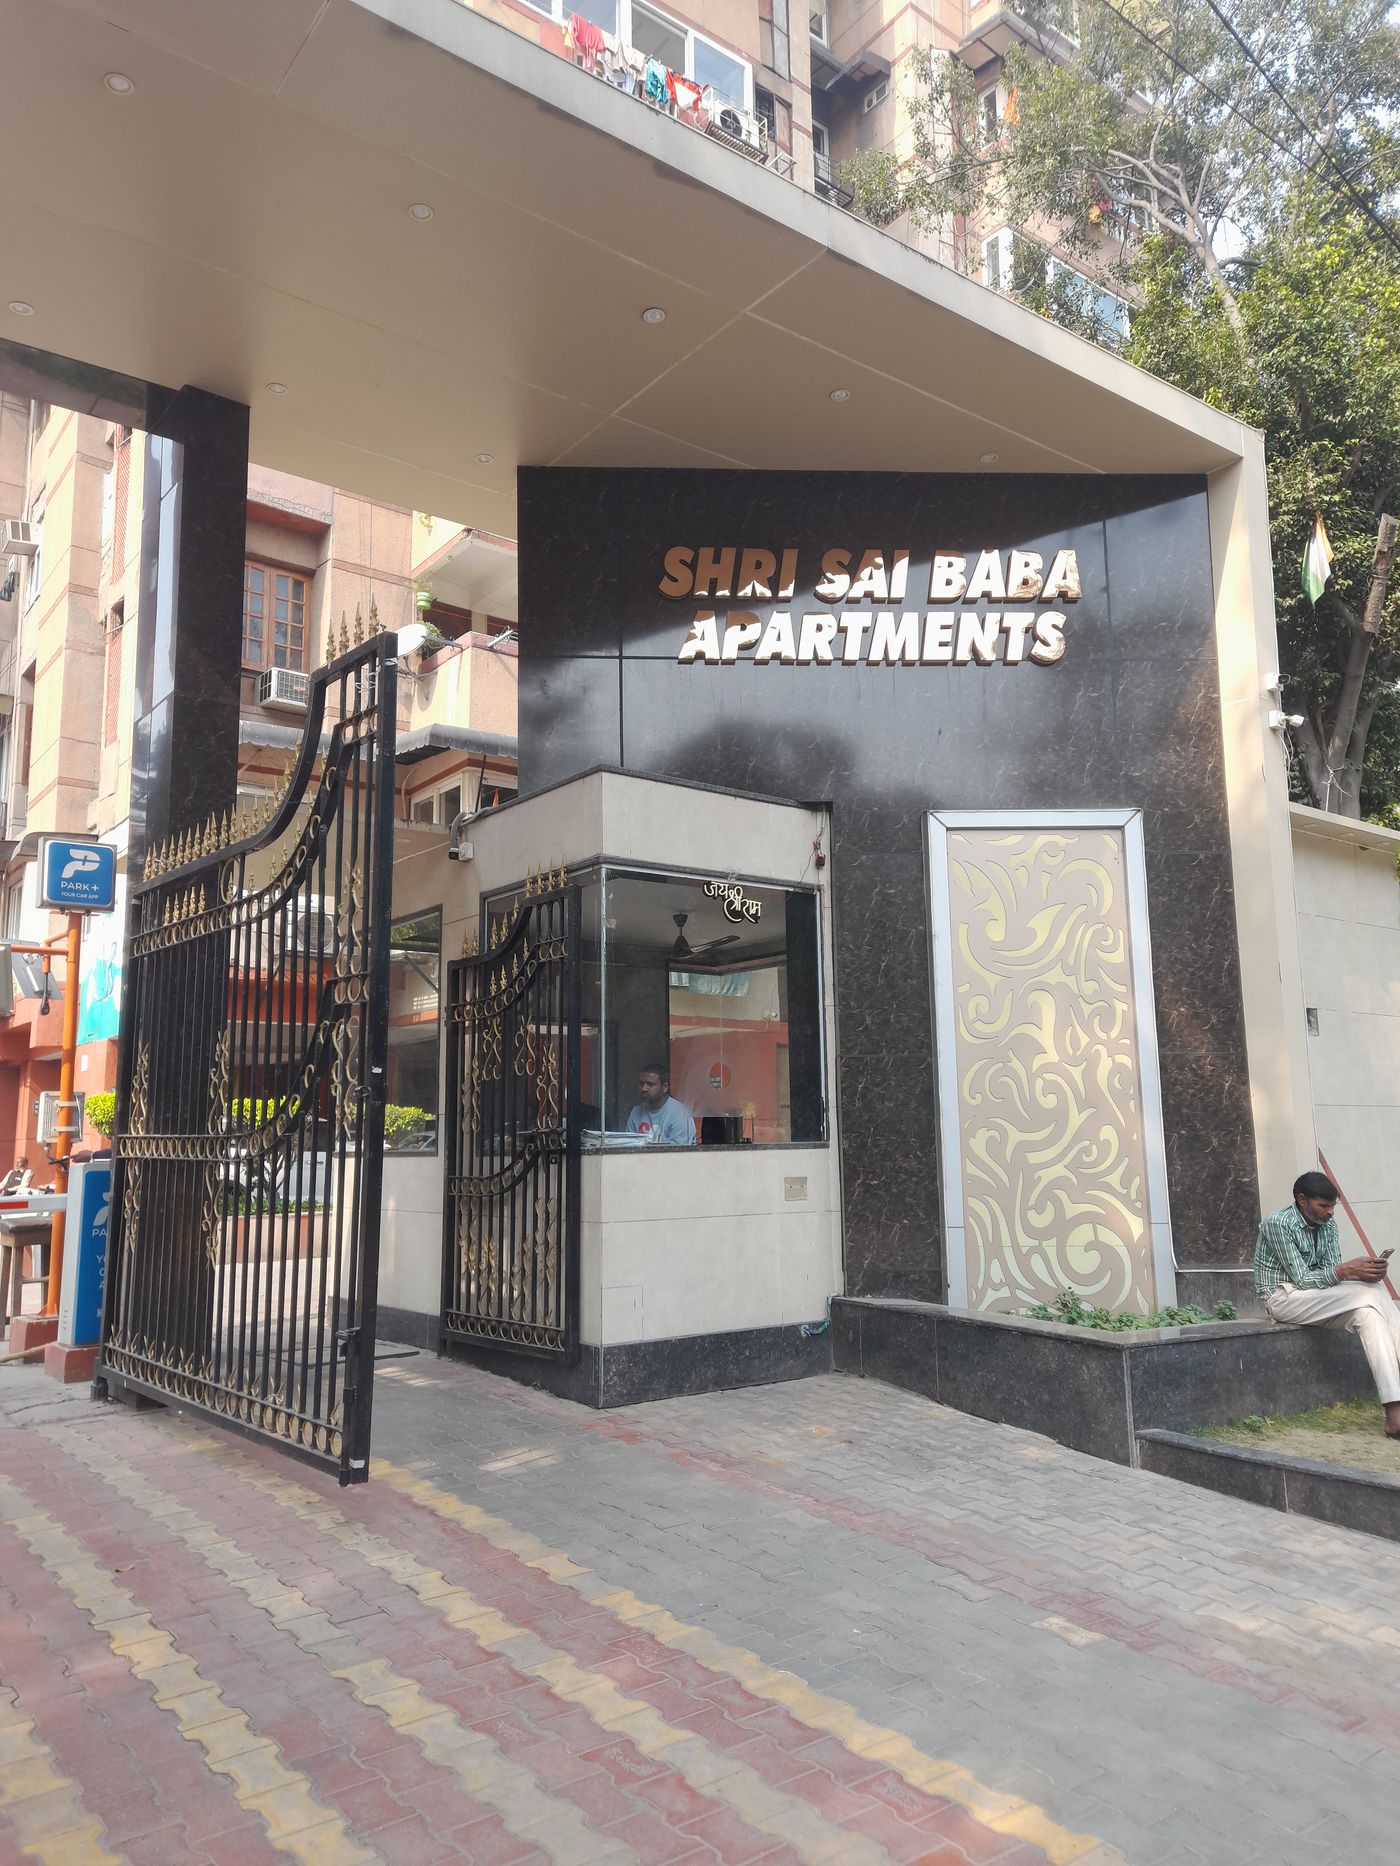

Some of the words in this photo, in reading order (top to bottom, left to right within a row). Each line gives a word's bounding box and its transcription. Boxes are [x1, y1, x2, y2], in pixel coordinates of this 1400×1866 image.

[658, 545, 799, 601] SHRI
[813, 548, 910, 604] SAI
[928, 549, 1082, 604] BABA
[677, 610, 1068, 667] APARTMENTS
[703, 880, 729, 899] जय
[723, 886, 743, 922] श्री
[741, 898, 762, 923] राम
